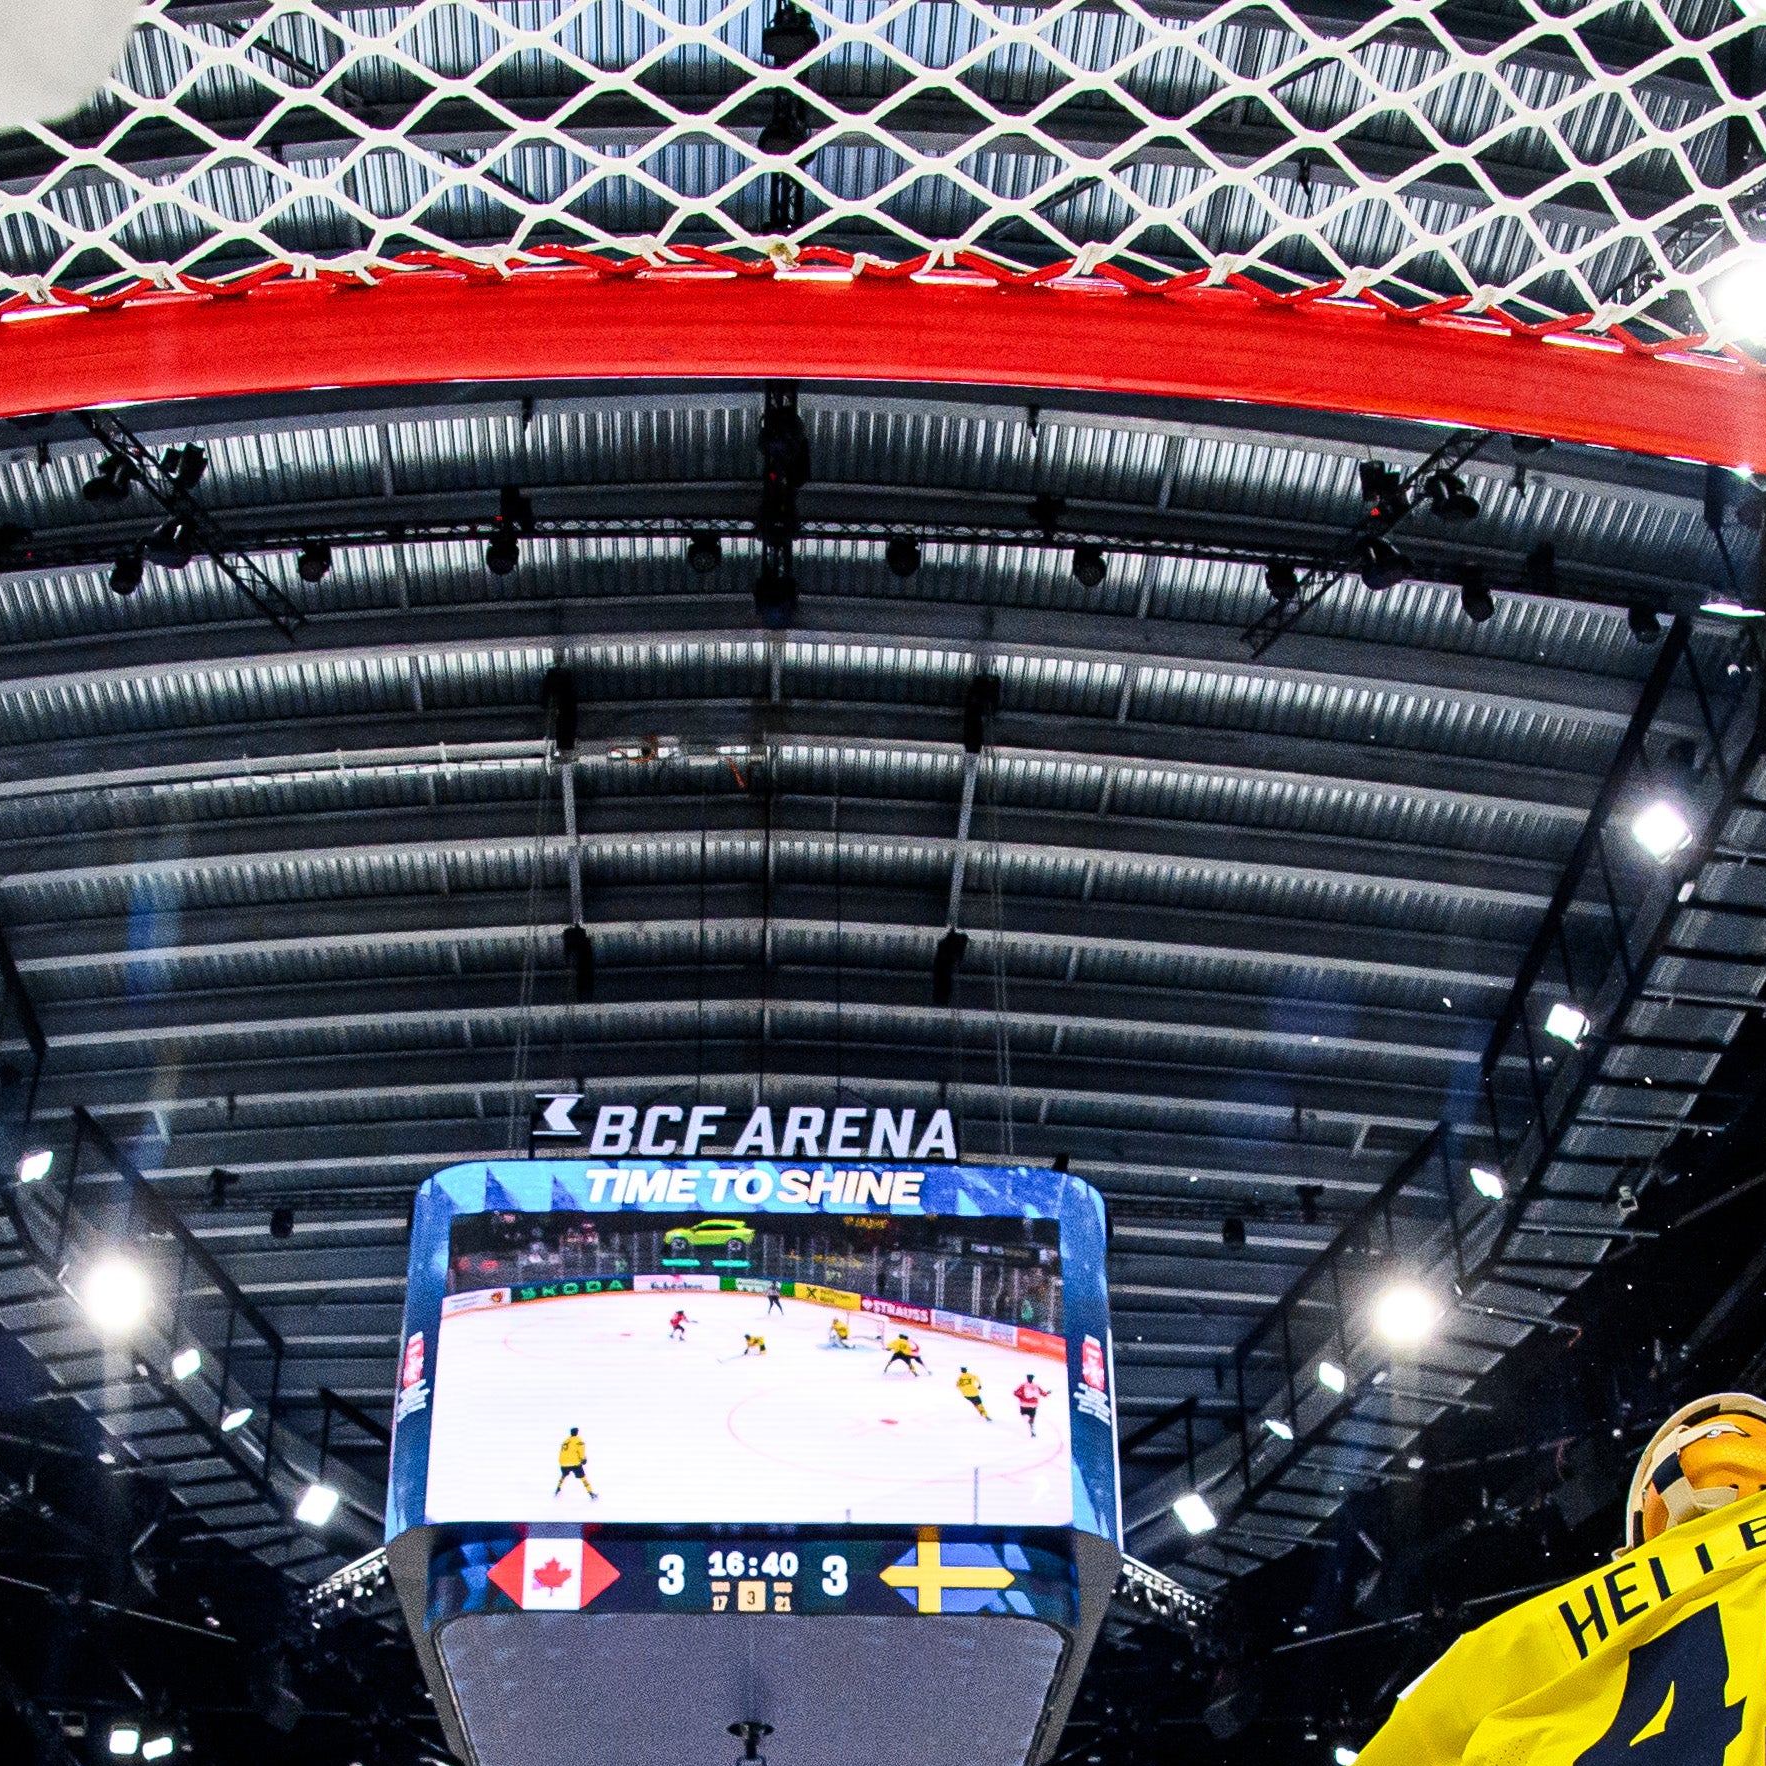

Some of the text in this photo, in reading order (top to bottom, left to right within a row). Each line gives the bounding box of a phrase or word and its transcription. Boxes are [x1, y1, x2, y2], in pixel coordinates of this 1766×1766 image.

[589, 1105, 958, 1160] BCF ARENA
[585, 1168, 926, 1206] TIME TO SHINE
[658, 1553, 685, 1596] 3
[707, 1550, 799, 1577] 16:40
[821, 1554, 849, 1597] 3
[746, 1590, 756, 1606] 3
